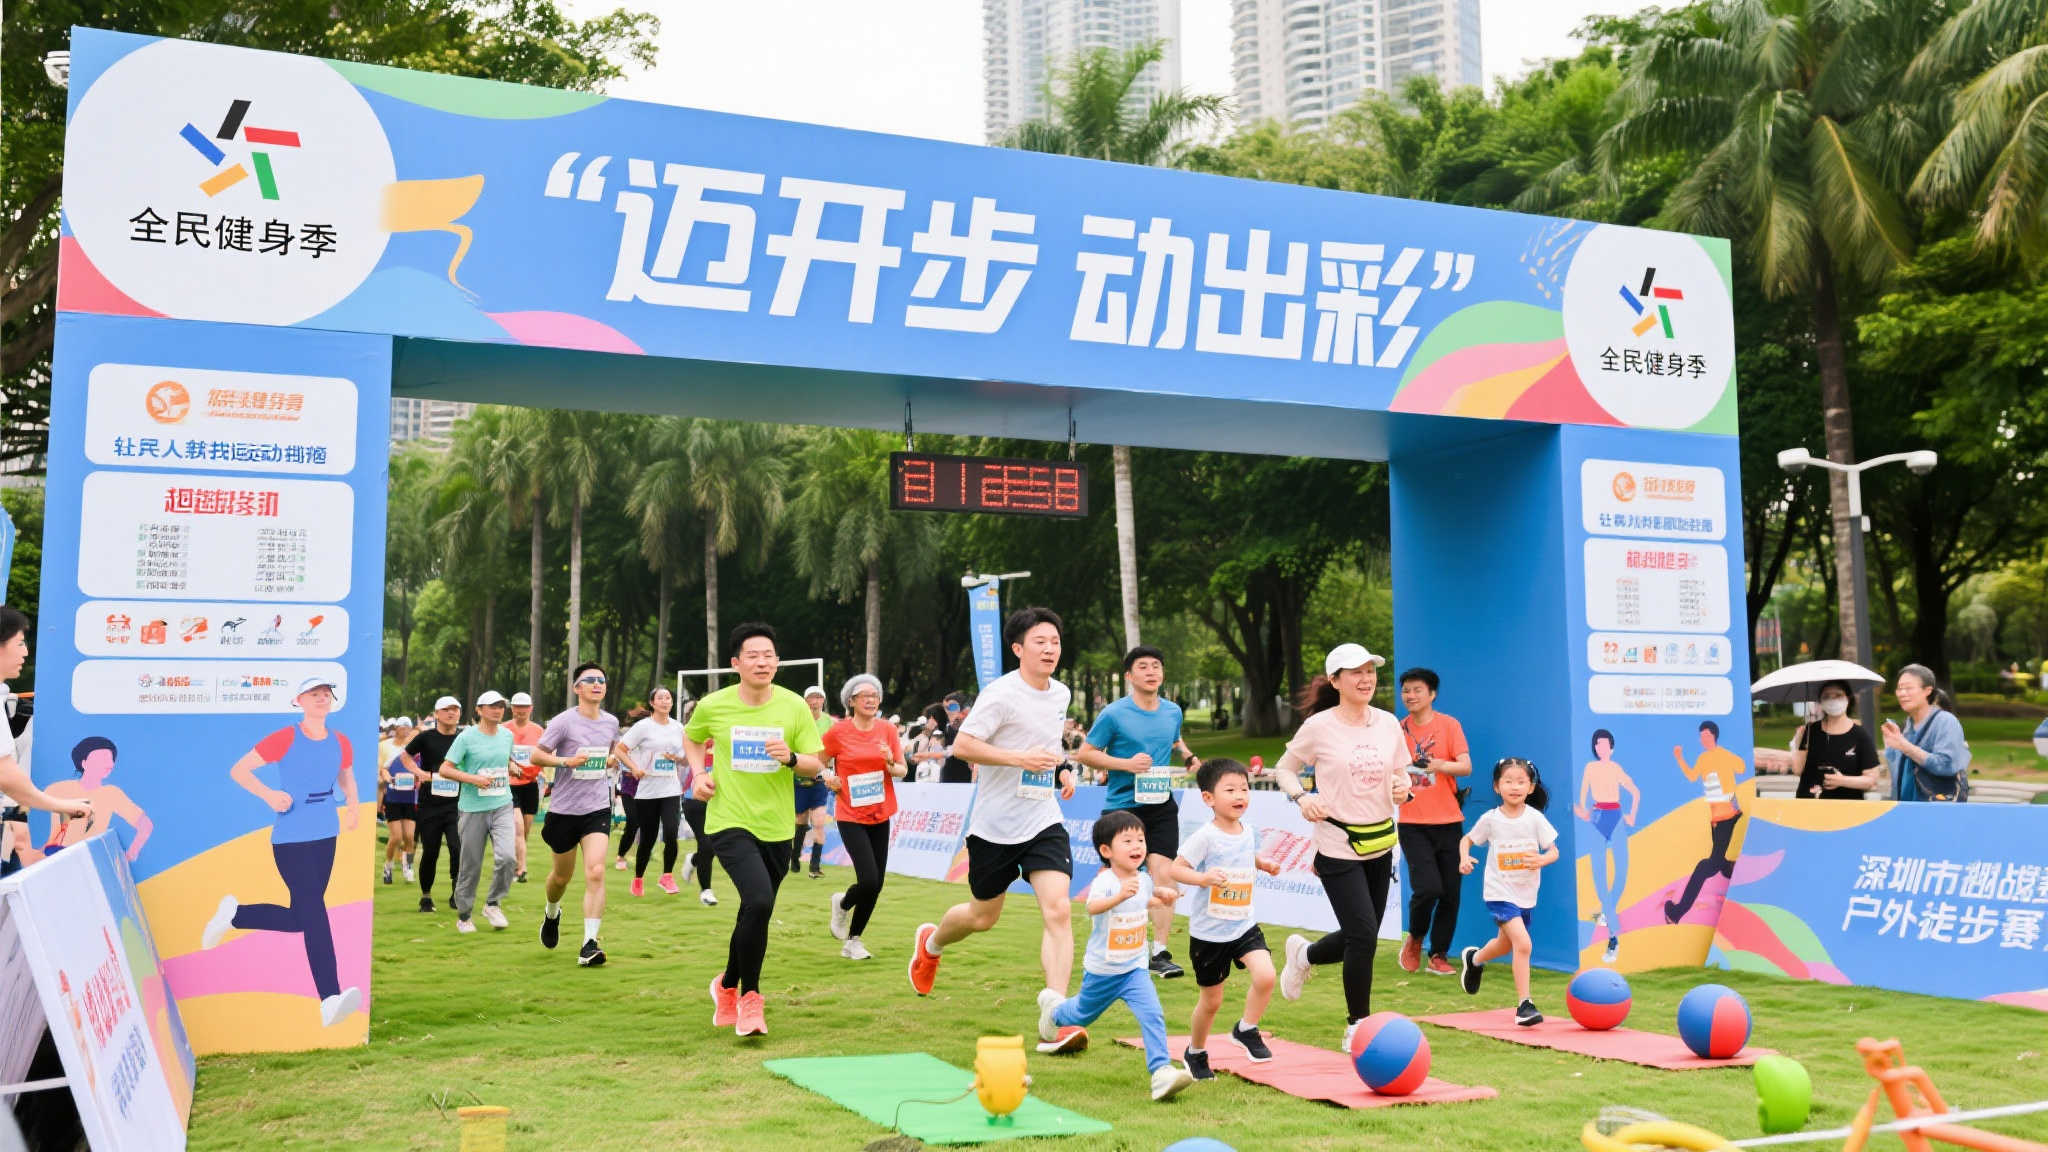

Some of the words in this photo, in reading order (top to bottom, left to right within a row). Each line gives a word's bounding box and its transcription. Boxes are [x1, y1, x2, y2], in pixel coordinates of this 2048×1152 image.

[128, 206, 338, 259] 全民健身季
[543, 150, 1040, 334] “迈开步
[1070, 213, 1476, 369] 动出彩”
[1600, 345, 1707, 379] 全民健身季
